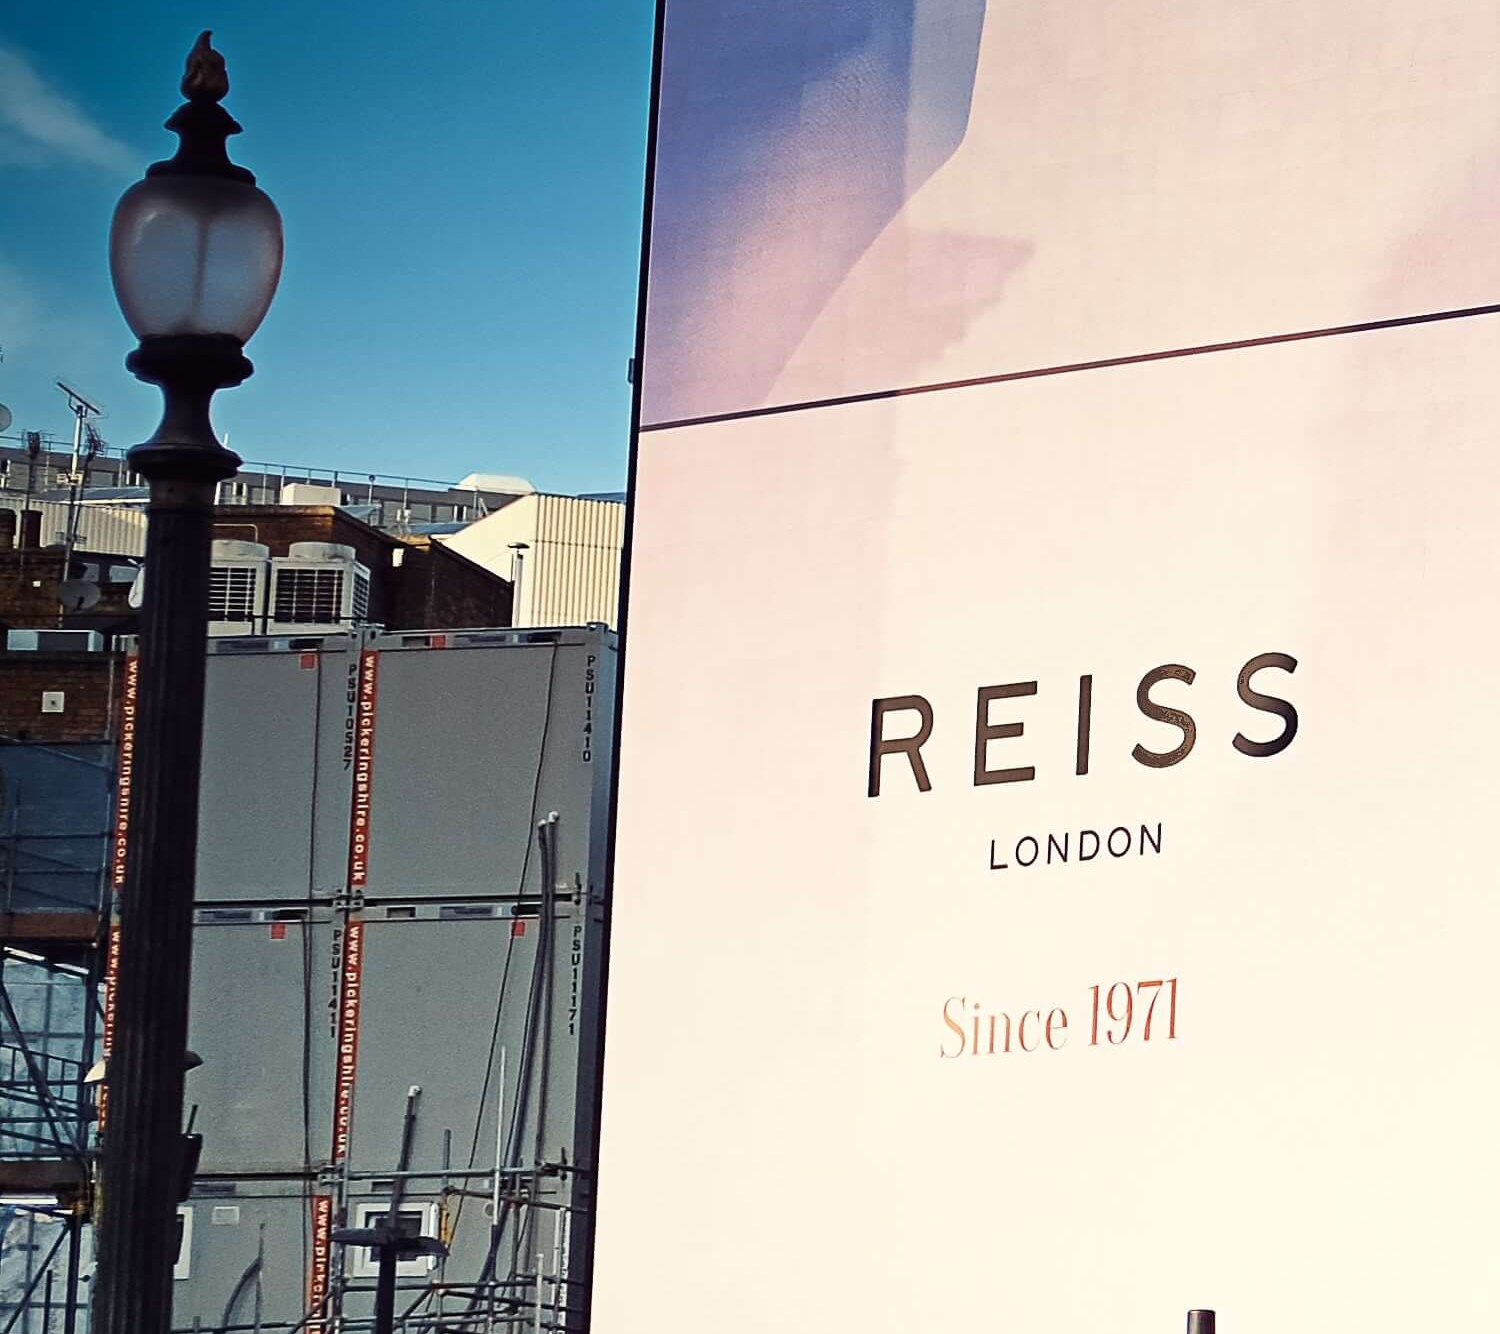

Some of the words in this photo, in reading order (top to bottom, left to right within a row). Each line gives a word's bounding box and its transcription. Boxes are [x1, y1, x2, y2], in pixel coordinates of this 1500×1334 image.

[581, 654, 597, 762] PSU11410
[867, 651, 1299, 799] REISS
[989, 821, 1164, 870] LONDON
[939, 994, 1068, 1060] Since
[1086, 976, 1180, 1048] 1971
